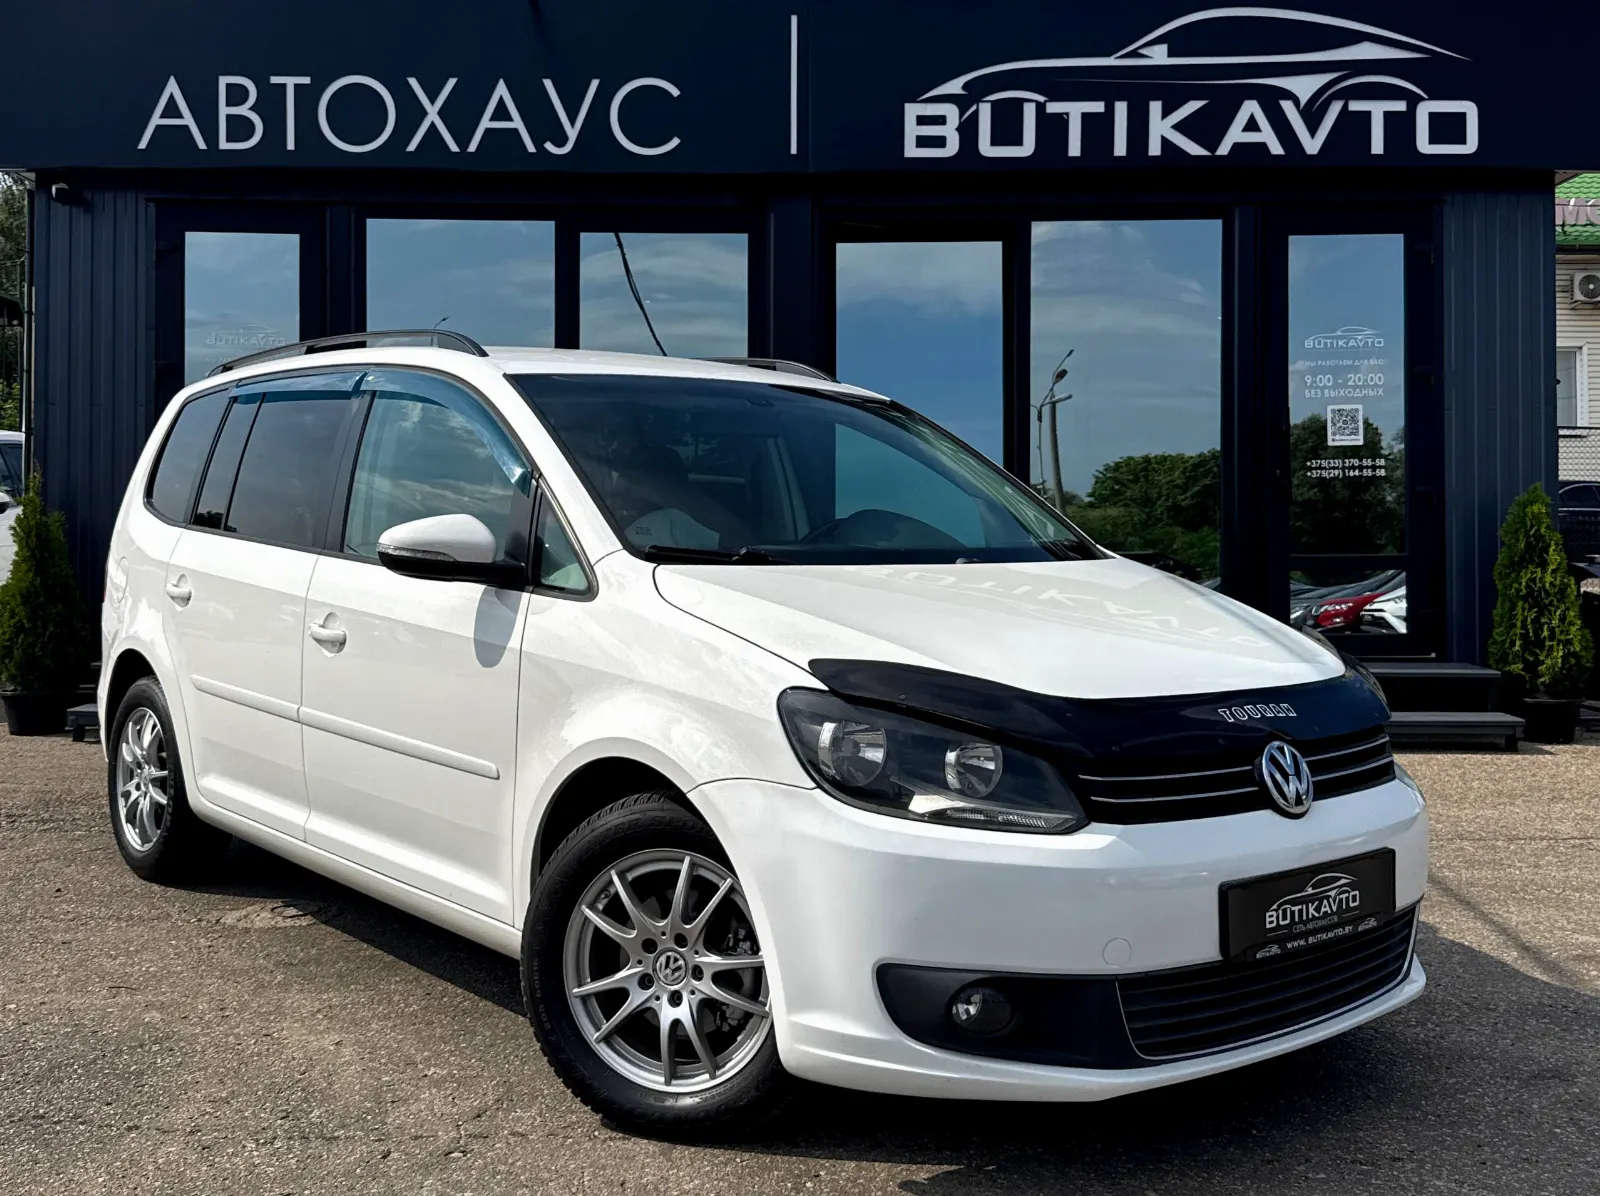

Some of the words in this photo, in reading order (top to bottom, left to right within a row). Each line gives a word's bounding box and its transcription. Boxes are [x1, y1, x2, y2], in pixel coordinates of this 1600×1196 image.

[137, 74, 682, 157] АВТОХАУС
[903, 98, 1479, 158] BUTIKAVTO
[207, 336, 286, 347] BUTIKAVTO
[1304, 338, 1385, 349] BUTIKAVTO
[1317, 359, 1353, 367] РАБОТАЕМ
[1304, 374, 1333, 387] 9:00
[1347, 373, 1384, 386] 20:00
[1304, 388, 1321, 398] БЕЗ
[1324, 387, 1385, 398] ВЫХОДНЫХ
[1306, 459, 1342, 469] +375(33)
[1344, 458, 1386, 468] 370-55-58
[1306, 469, 1343, 479] +375(29)
[1344, 468, 1386, 477] 164-55-58
[1217, 703, 1298, 723] TOURAN
[1265, 889, 1361, 929] BUTIKAVTO
[1292, 923, 1306, 933] СЕТЬ
[1308, 925, 1354, 945] BUTIKAVTO.BY
